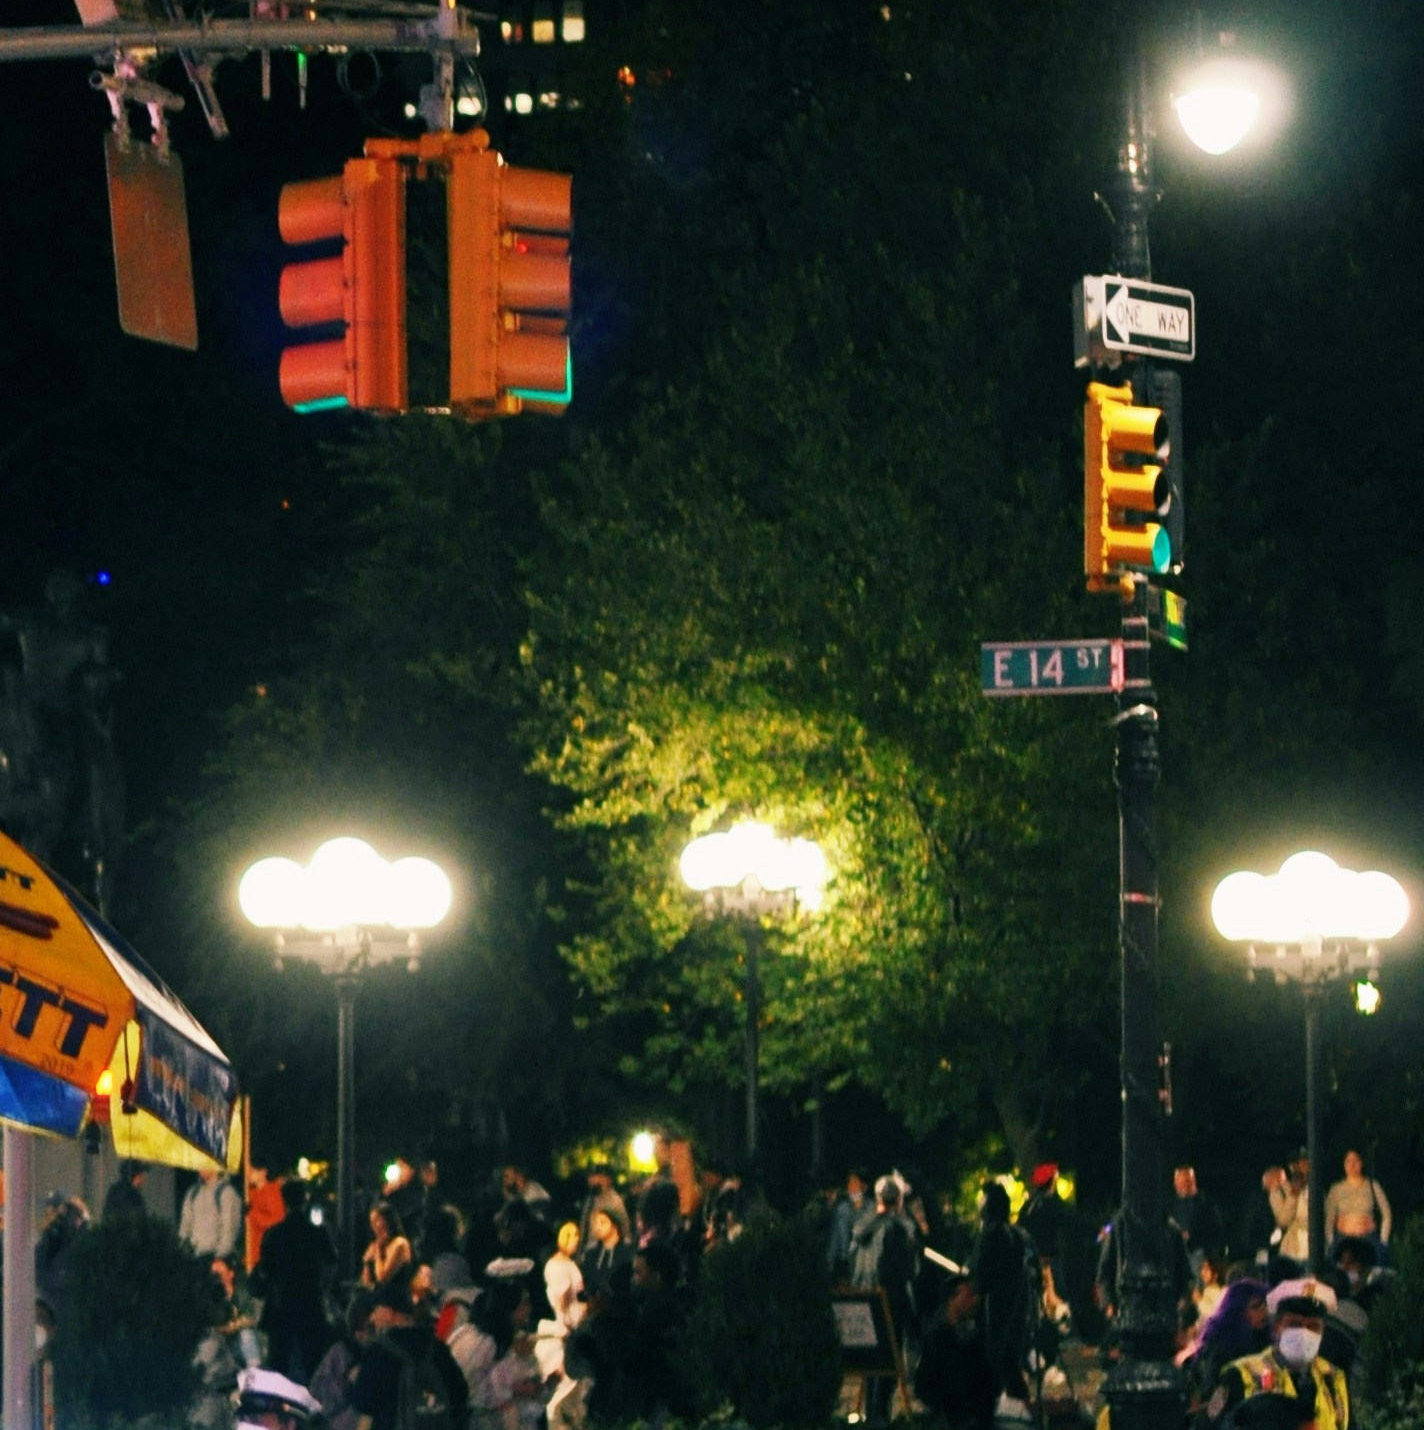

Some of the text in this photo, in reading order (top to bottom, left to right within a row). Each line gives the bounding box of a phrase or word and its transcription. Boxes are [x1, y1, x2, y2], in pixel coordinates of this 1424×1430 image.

[1116, 301, 1186, 335] ONE WAY
[993, 647, 1103, 689] E 14 ST
